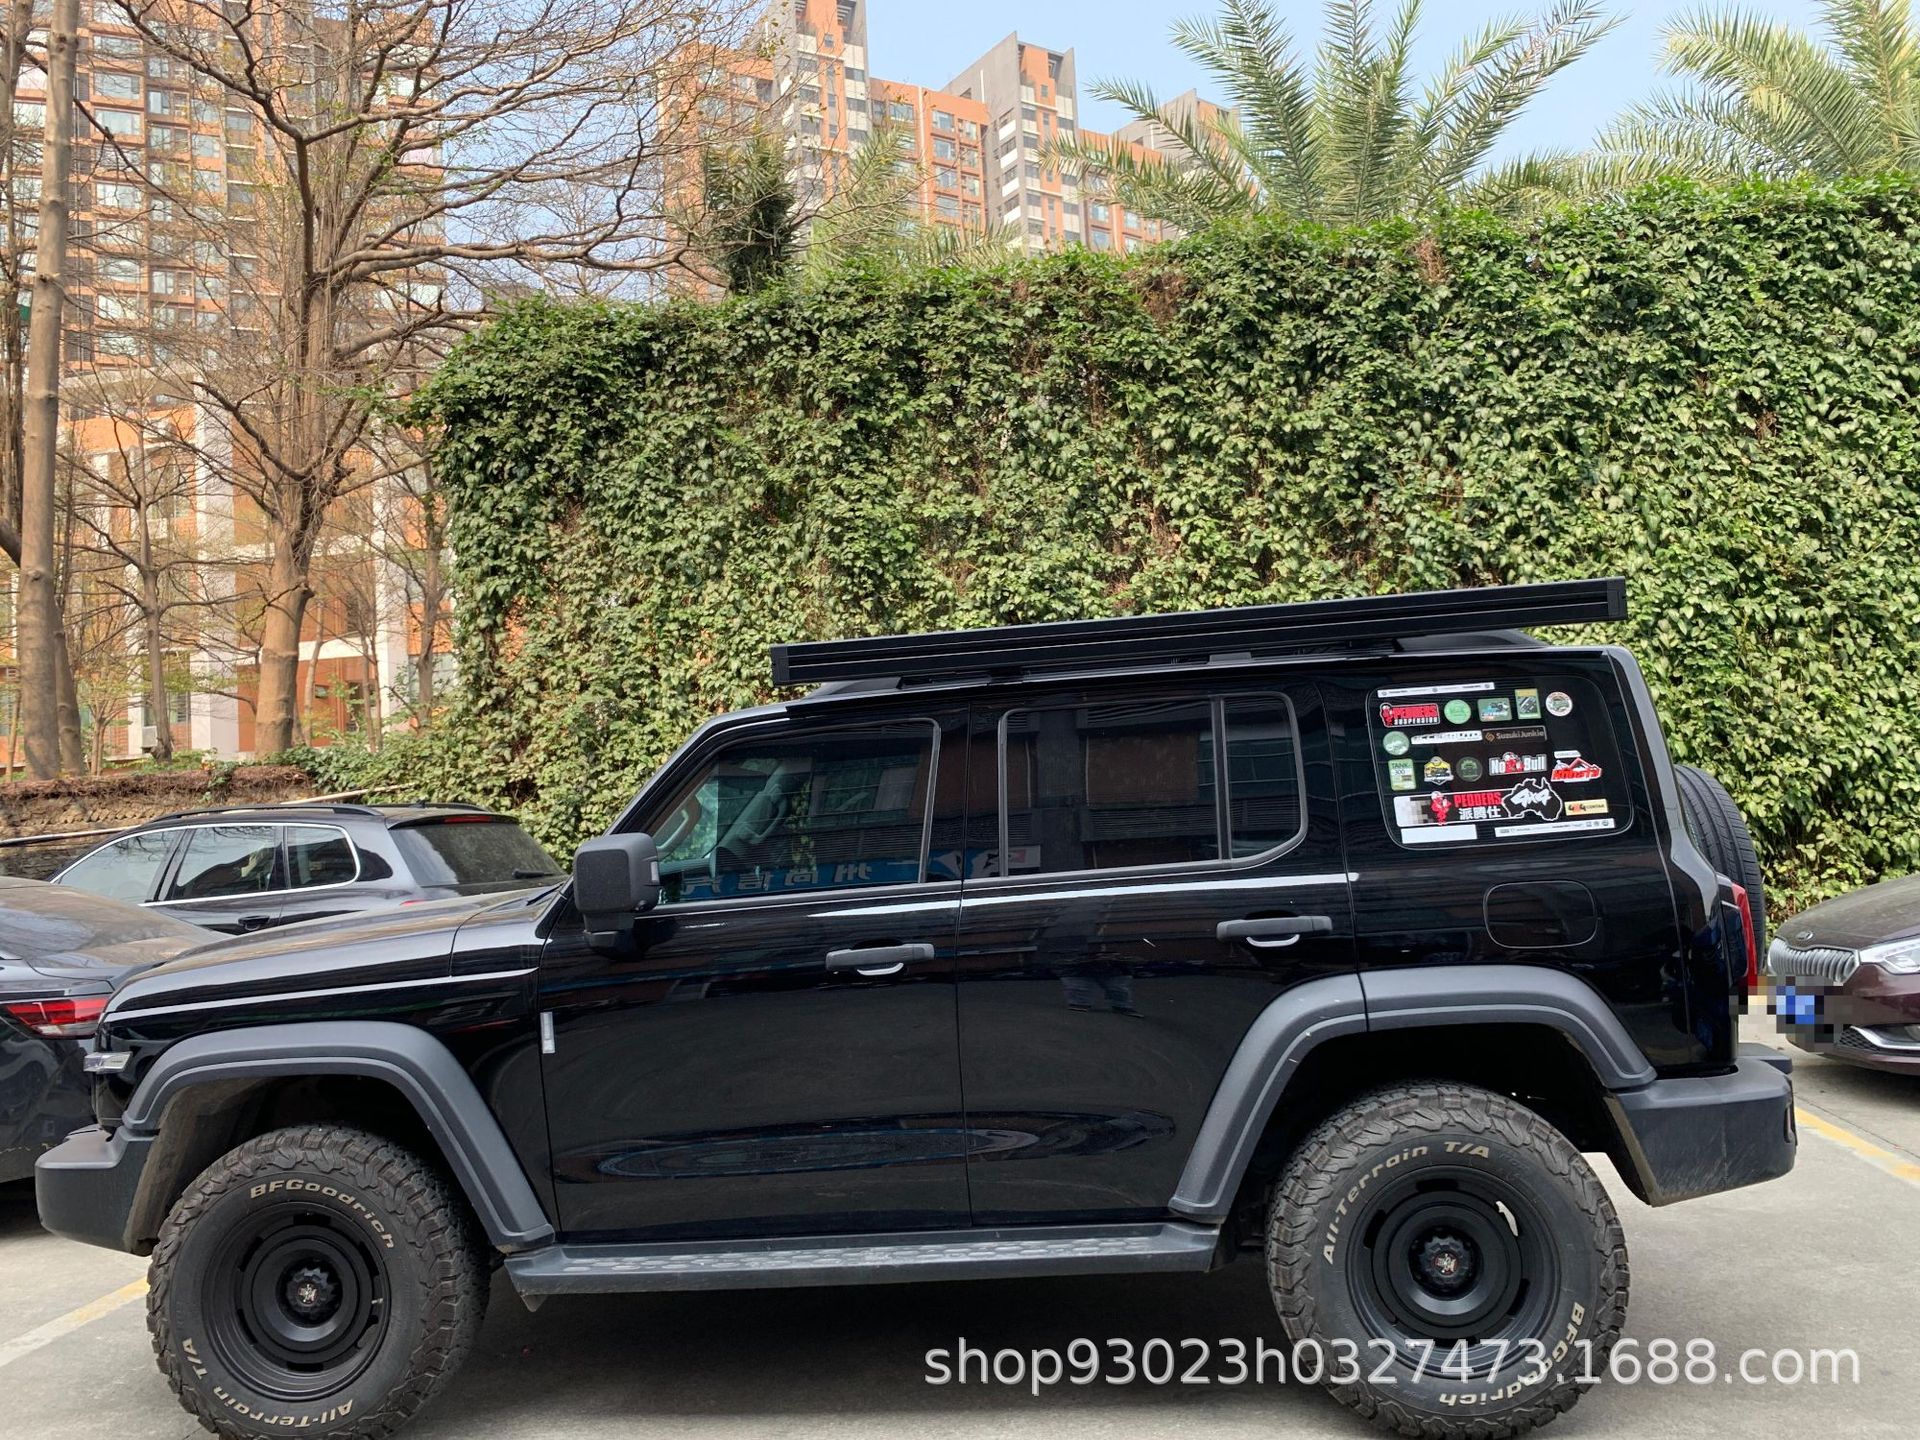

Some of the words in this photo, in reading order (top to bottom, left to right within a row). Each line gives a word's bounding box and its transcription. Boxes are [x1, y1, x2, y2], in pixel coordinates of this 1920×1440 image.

[1453, 792, 1502, 808] PEDDERS
[249, 1178, 395, 1249] BFGoodrich
[1323, 1145, 1428, 1265] All-Terrain
[1443, 1140, 1490, 1159] T/A
[182, 1337, 208, 1380] T/A
[213, 1386, 353, 1428] All-Terrain
